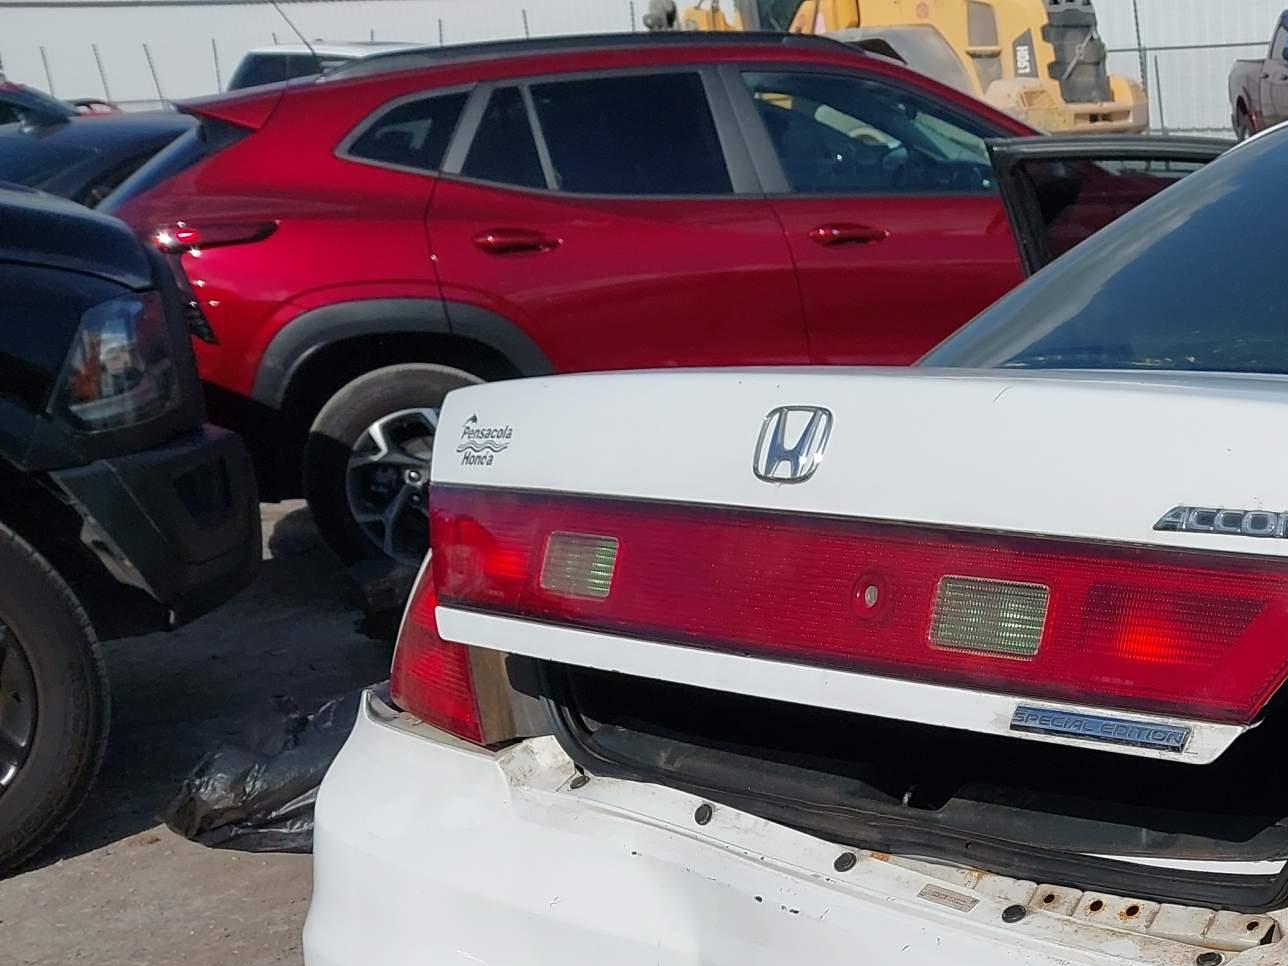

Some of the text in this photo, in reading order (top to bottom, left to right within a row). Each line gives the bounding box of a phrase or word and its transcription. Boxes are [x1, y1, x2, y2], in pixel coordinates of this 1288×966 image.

[461, 425, 513, 440] Pensacola
[461, 450, 494, 466] Honda
[1013, 710, 1185, 744] SPECIAL EDITION
